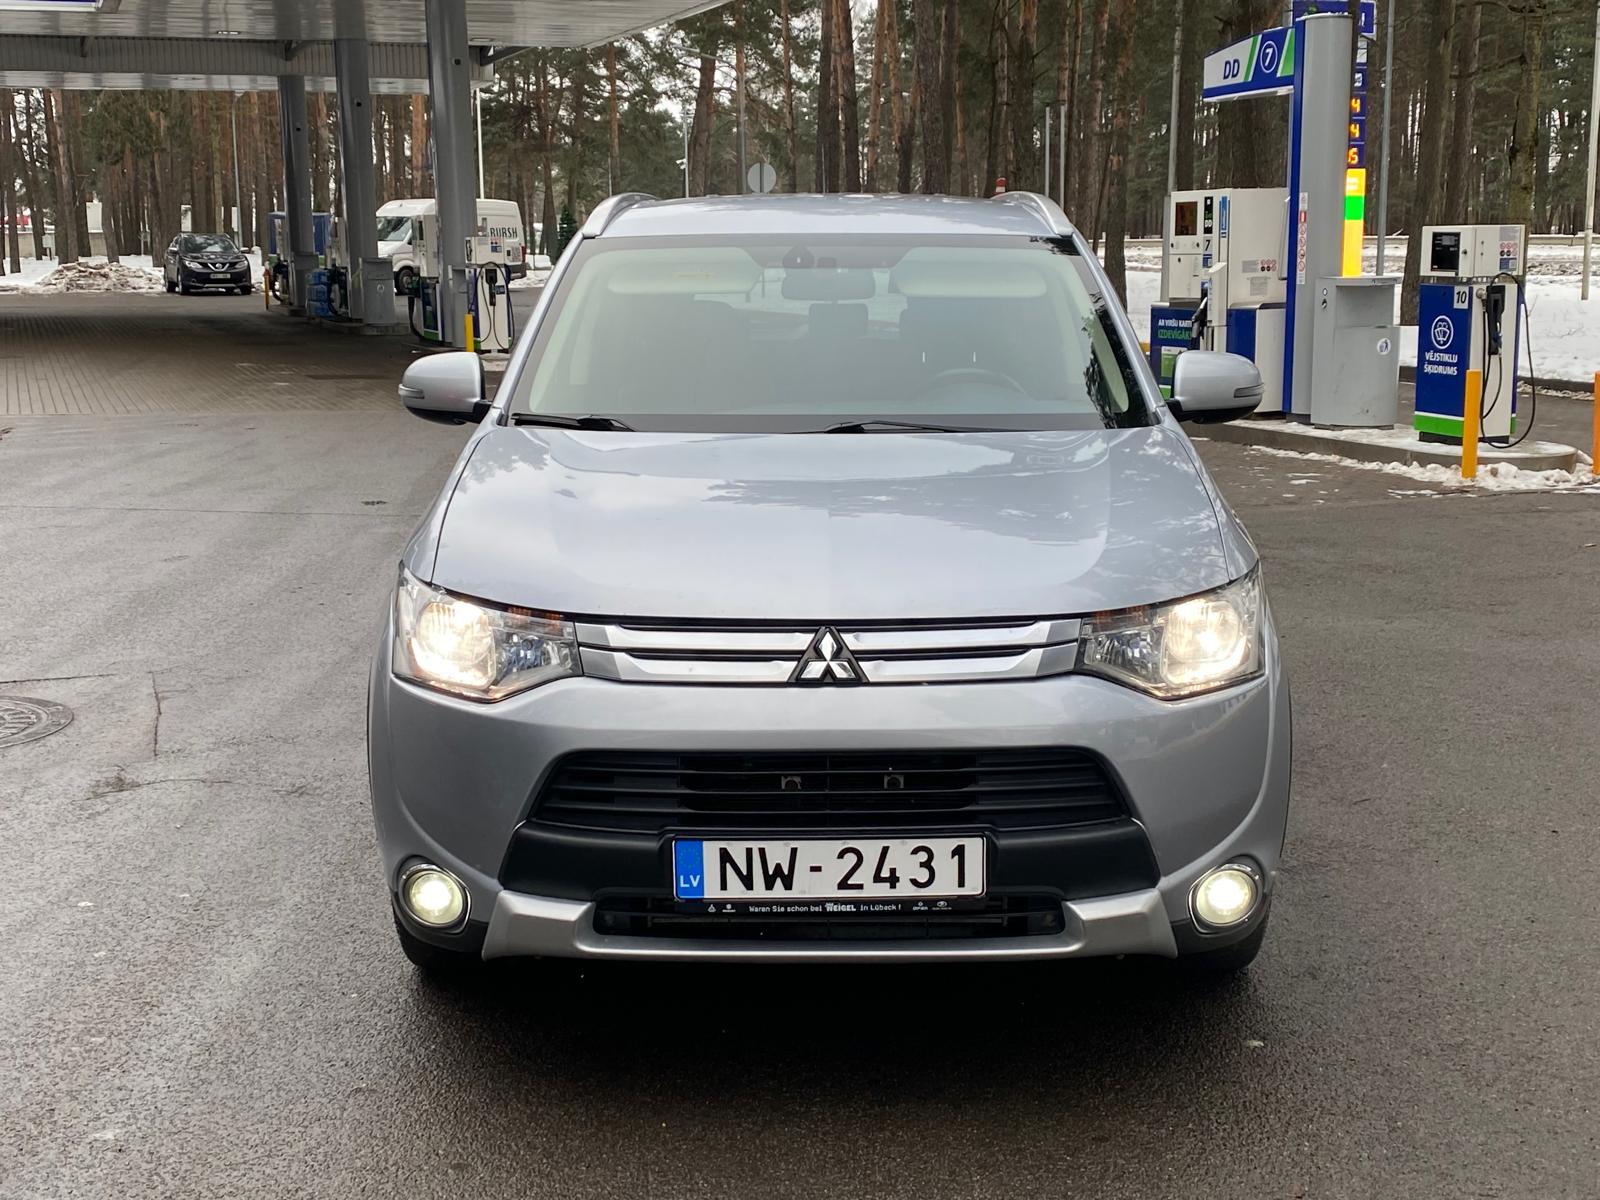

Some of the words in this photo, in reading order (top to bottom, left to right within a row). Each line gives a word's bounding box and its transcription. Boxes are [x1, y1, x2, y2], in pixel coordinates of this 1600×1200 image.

[1264, 47, 1273, 67] 7
[1223, 59, 1240, 79] DD
[1205, 239, 1211, 251] 7
[1456, 291, 1467, 304] 10
[1425, 350, 1458, 363] VĒJSTIKLU
[1424, 361, 1458, 376] ŠĶIDRUMS
[718, 843, 966, 892] NW-2431
[680, 875, 700, 888] LV
